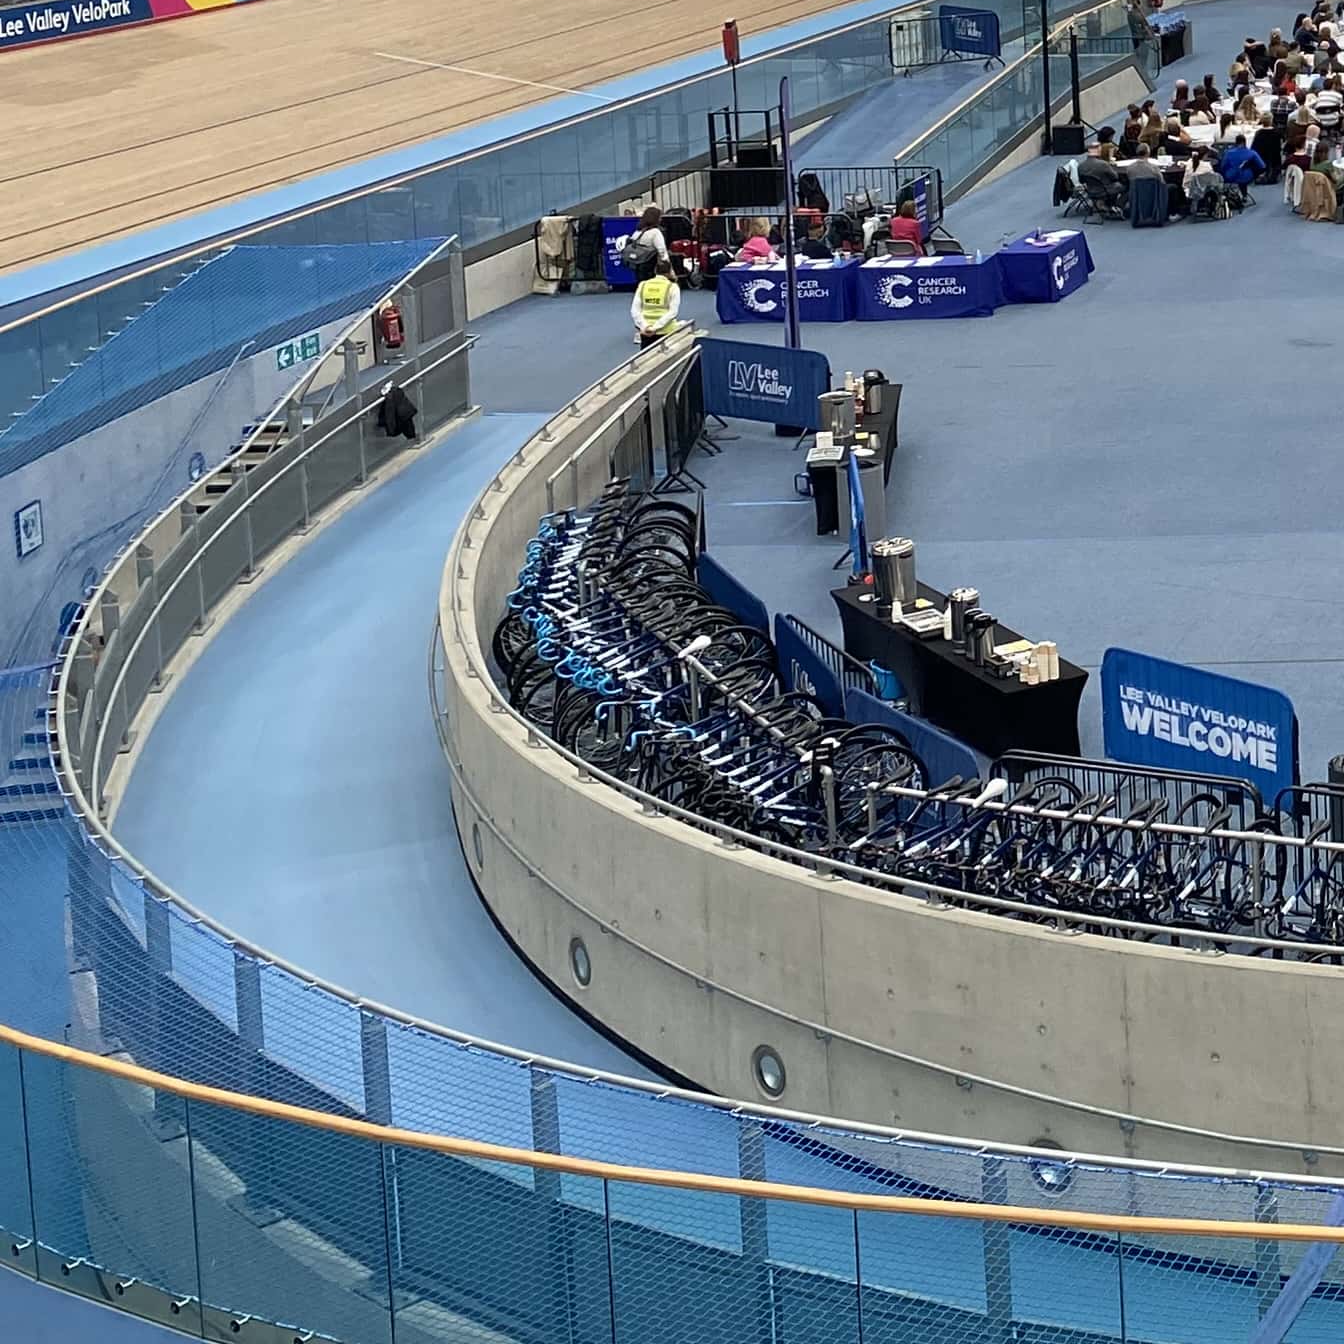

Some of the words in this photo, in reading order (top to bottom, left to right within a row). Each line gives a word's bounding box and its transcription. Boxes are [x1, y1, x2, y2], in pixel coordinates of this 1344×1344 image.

[0, 17, 24, 37] Lee
[25, 8, 70, 33] Valley
[780, 280, 819, 289] CNCER
[917, 277, 957, 286] CANCER
[781, 288, 830, 298] REARCH
[917, 286, 966, 296] RESEARCH
[918, 295, 932, 305] UK
[757, 363, 779, 380] Lee
[757, 378, 793, 399] Valley
[1119, 684, 1144, 699] LEE
[1147, 691, 1200, 718] VALLEY
[1200, 707, 1277, 741] VELOPARK
[1120, 700, 1278, 773] WELCOME
